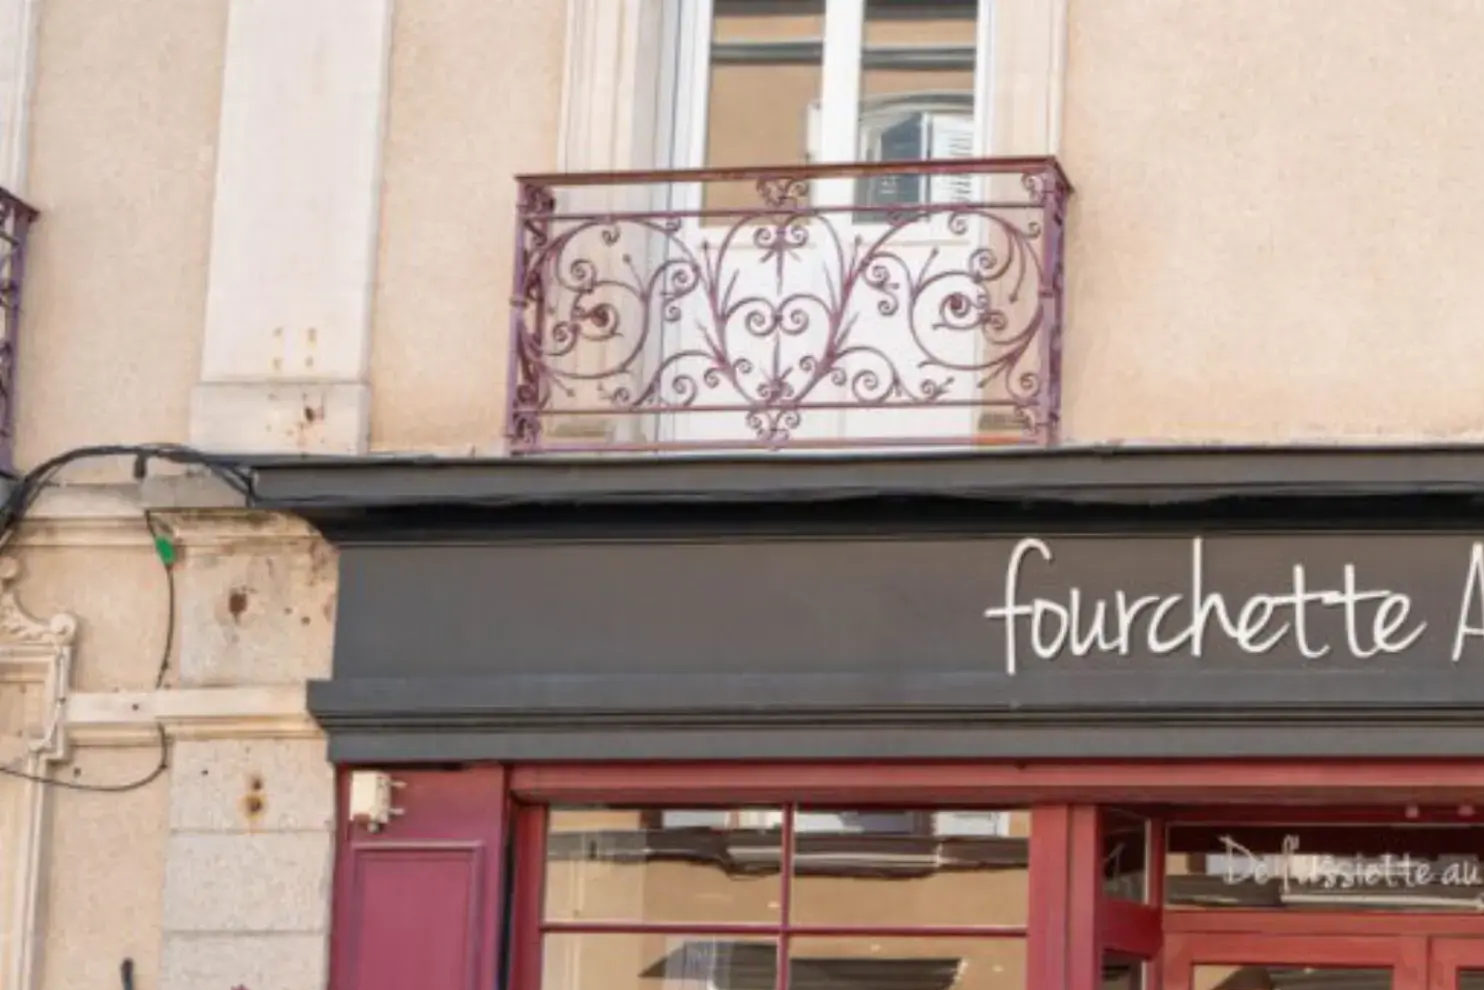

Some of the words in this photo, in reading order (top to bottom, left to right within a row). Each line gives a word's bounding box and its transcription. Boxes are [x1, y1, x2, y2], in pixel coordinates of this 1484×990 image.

[984, 534, 1428, 676] fourchette
[1218, 834, 1269, 886] De
[1439, 858, 1484, 886] au
